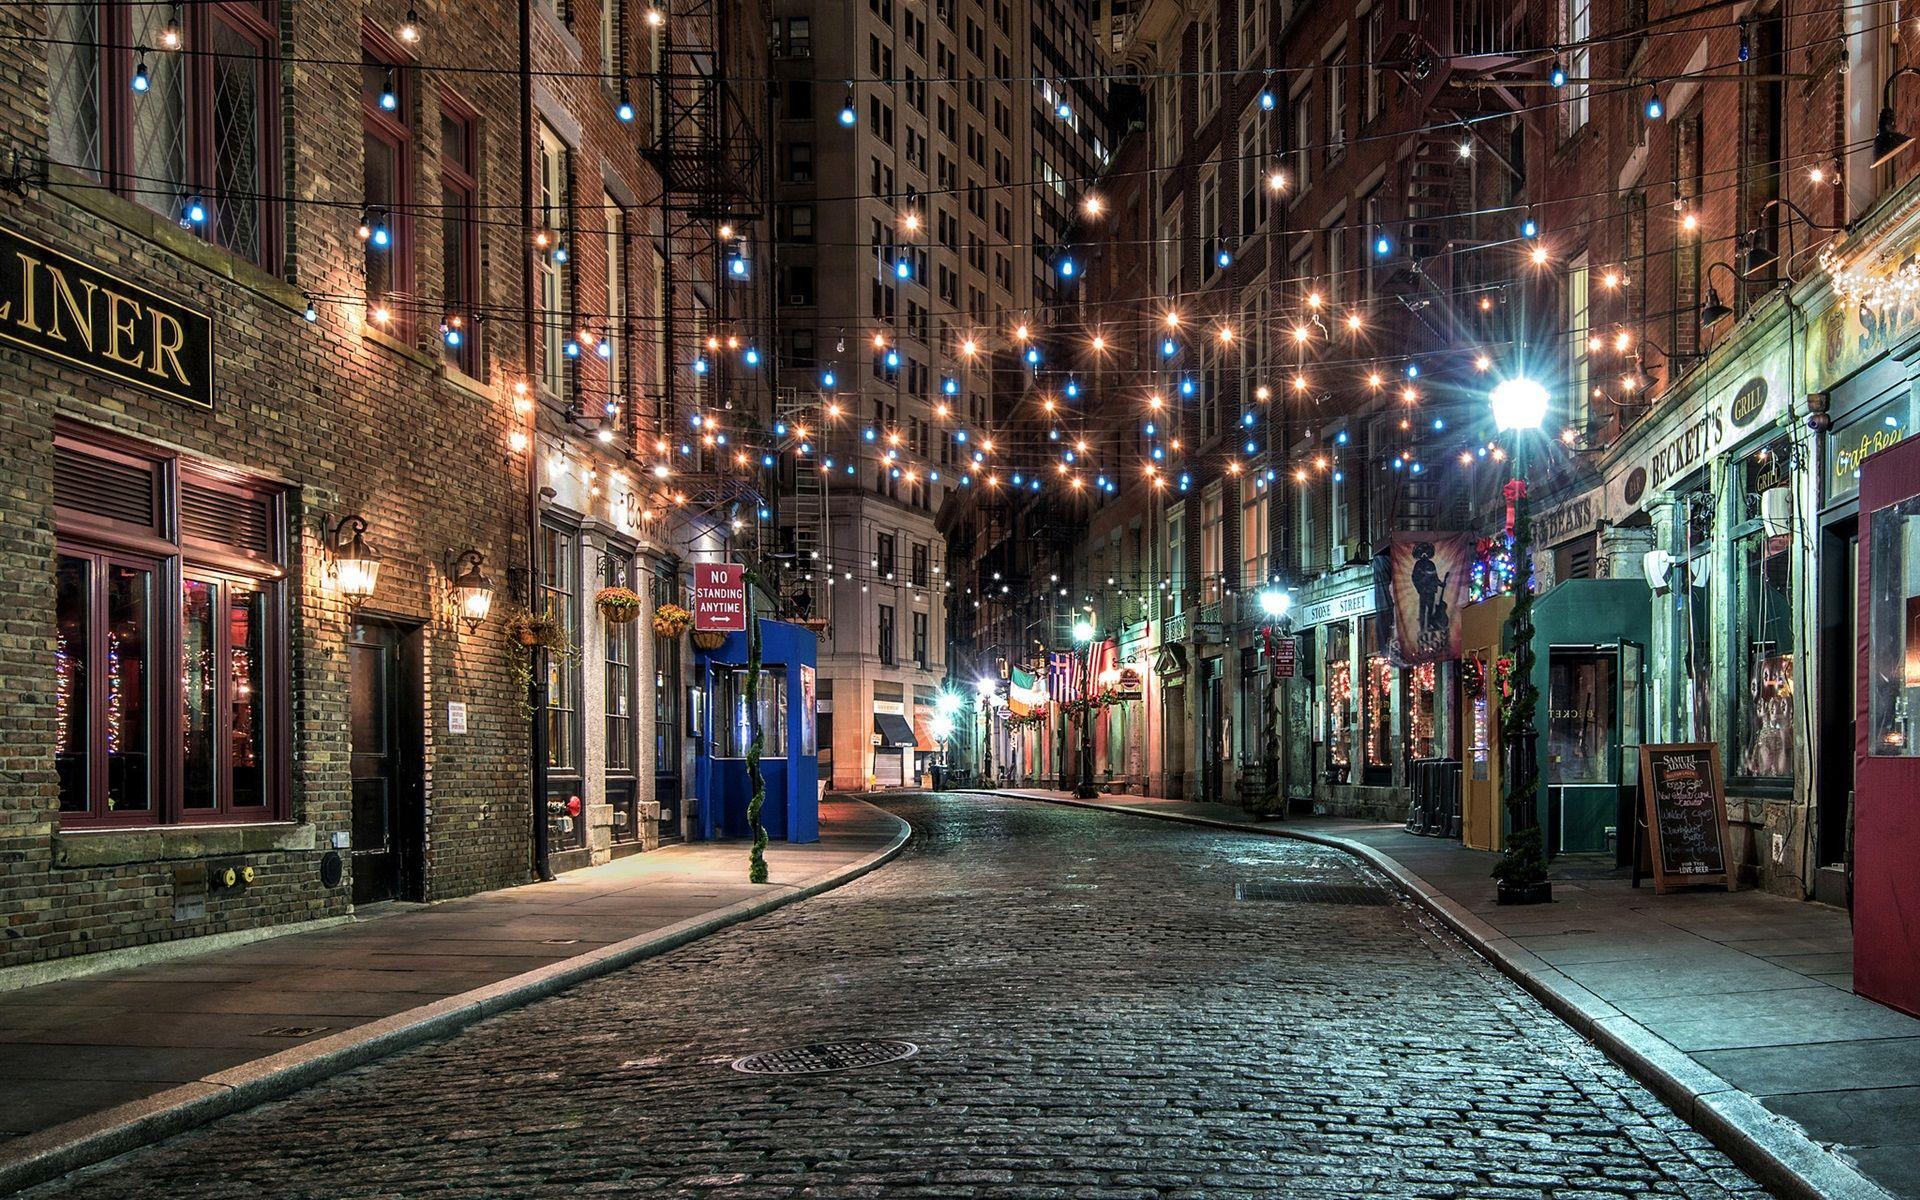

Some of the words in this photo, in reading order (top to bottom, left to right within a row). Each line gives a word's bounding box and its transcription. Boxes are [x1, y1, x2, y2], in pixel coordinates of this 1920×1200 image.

[0, 251, 191, 387] INER
[1734, 387, 1763, 421] GRILL
[1651, 403, 1723, 490] BECKETT'S
[1836, 434, 1872, 477] Craft
[1757, 467, 1780, 491] GRILL
[711, 571, 728, 584] NO
[697, 588, 743, 599] STANDING
[700, 602, 741, 613] ANYTIME
[1311, 603, 1331, 621] STONE
[1340, 595, 1366, 613] STREET
[1662, 754, 1698, 765] SAMUEL
[1666, 760, 1697, 772] ADAMS
[1695, 865, 1710, 873] BEER
